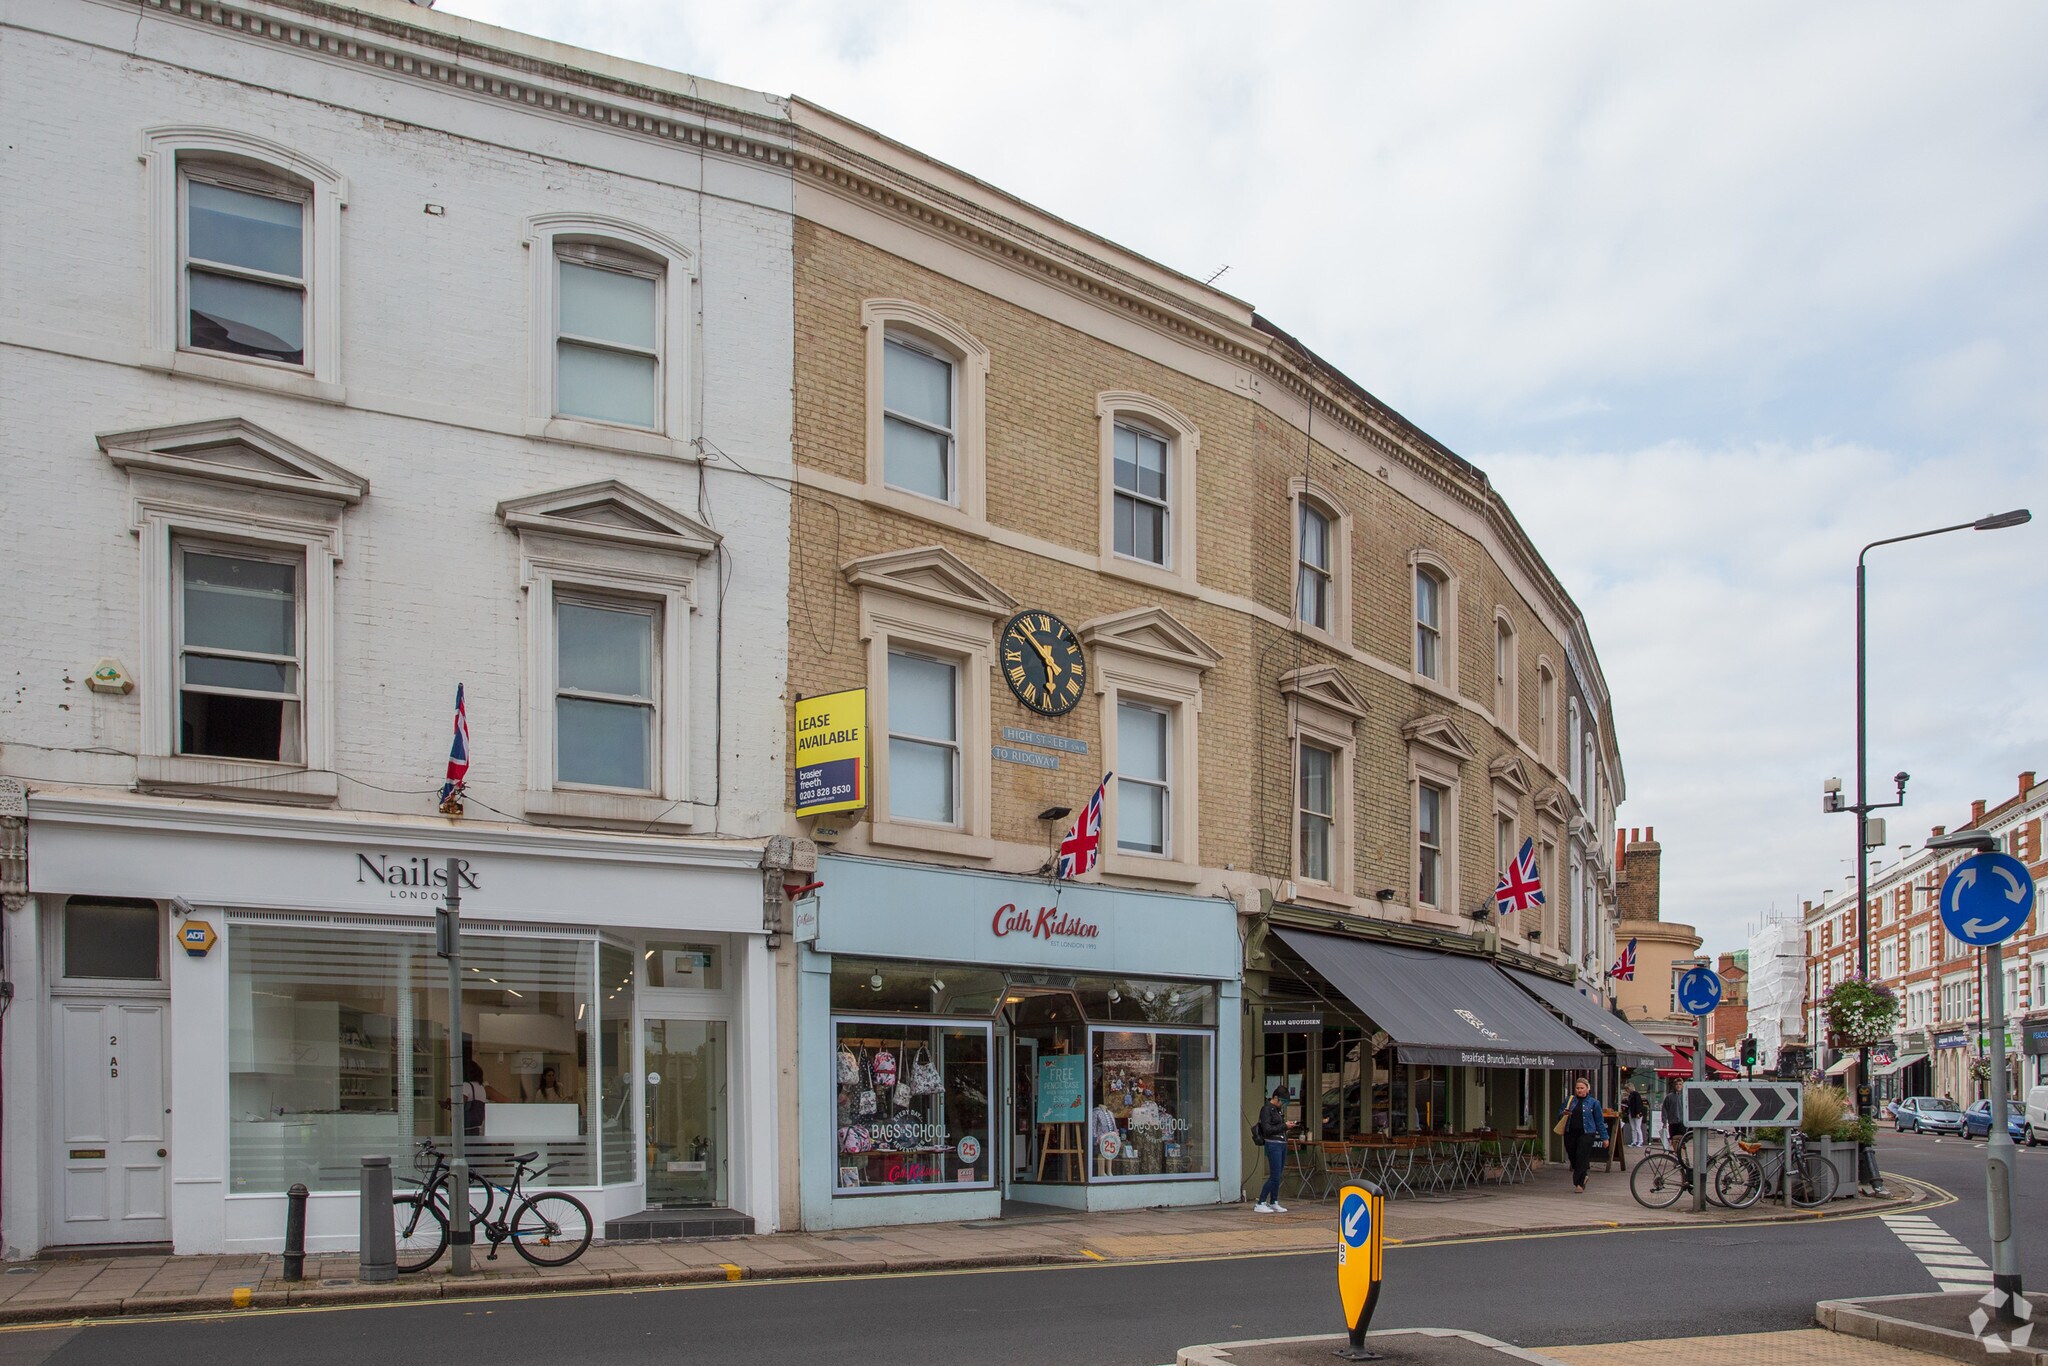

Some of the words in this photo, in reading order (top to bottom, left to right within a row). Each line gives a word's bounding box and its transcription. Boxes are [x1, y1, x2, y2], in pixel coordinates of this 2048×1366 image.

[798, 714, 830, 732] LEASE
[798, 728, 858, 751] AVAILABLE
[1008, 729, 1032, 742] HIGH
[1036, 734, 1068, 748] STREET
[995, 748, 1008, 758] TO
[1012, 751, 1055, 766] RIDGWAY
[800, 768, 822, 780] brasier
[800, 778, 821, 790] freeth
[800, 790, 815, 800] 0203
[816, 786, 830, 797] 828
[832, 784, 850, 795] 8530
[356, 853, 447, 888] Nails
[992, 904, 1033, 938] Cath
[1033, 906, 1099, 940] Kidston
[186, 932, 205, 940] ADT
[110, 1036, 117, 1046] 2
[1462, 1052, 1486, 1064] Breakfast,
[1487, 1054, 1506, 1066] Brunch,
[1522, 1056, 1537, 1066] Dinner
[1538, 1056, 1542, 1066] &
[1542, 1056, 1554, 1066] Wine
[1050, 1068, 1074, 1080] FREE
[1044, 1081, 1064, 1090] PENCIL
[894, 1110, 909, 1122] EVERY
[872, 1124, 900, 1142] BAGS
[905, 1124, 950, 1142] SCHOOL
[1154, 1118, 1188, 1134] SCHOOL
[963, 1142, 976, 1156] 25
[1104, 1140, 1116, 1154] 25
